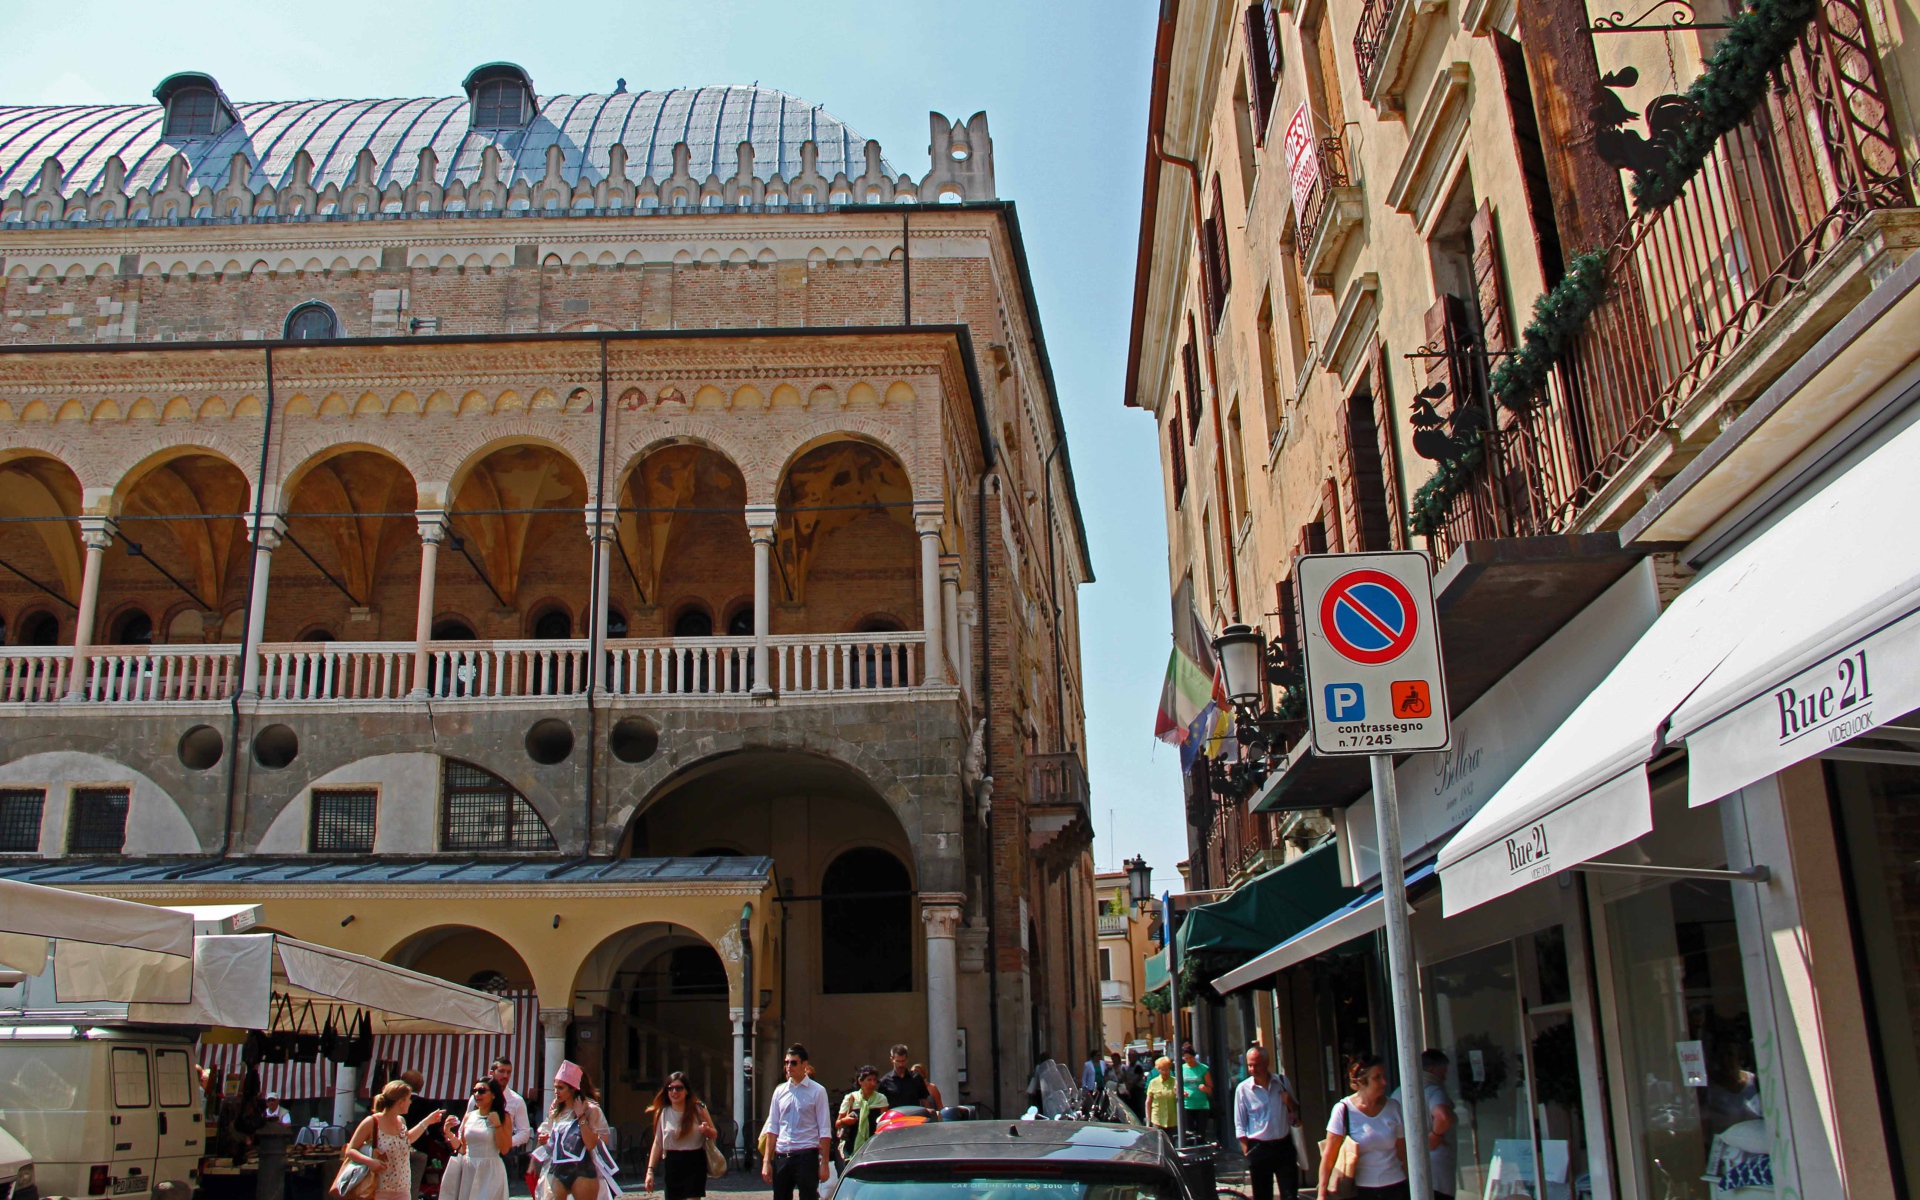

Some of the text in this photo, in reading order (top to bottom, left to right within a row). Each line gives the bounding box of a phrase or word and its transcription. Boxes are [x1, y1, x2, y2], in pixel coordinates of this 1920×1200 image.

[1333, 687, 1358, 718] P
[1775, 649, 1873, 740] Rue 21
[1338, 722, 1423, 734] contrassegno
[1827, 711, 1874, 744] VIDEO LOOK
[1433, 727, 1480, 796] Bellora
[1505, 823, 1550, 871] Rue 21
